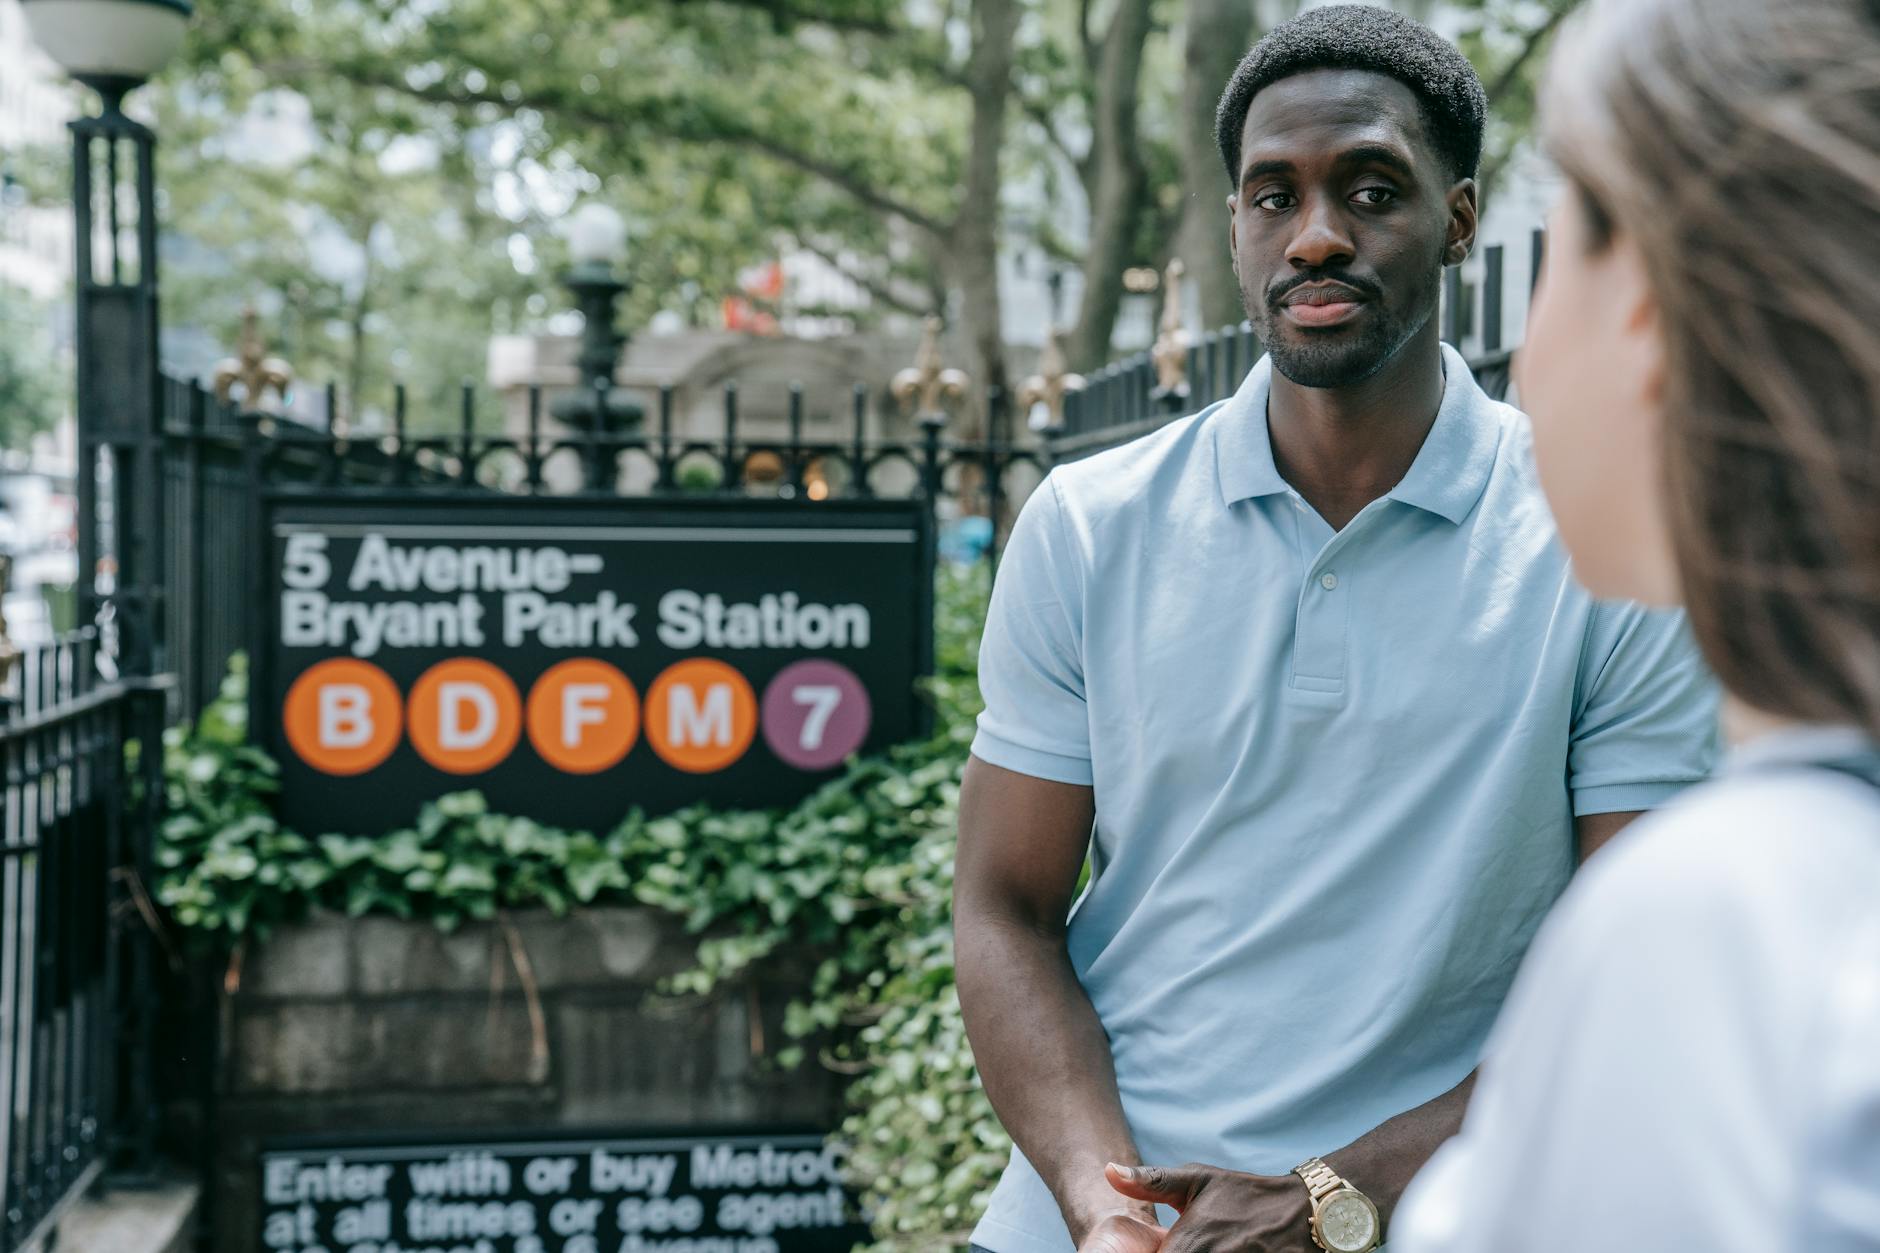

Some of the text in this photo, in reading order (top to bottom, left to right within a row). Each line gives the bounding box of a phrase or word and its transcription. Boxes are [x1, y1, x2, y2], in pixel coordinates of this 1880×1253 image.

[282, 533, 331, 589] 5
[280, 589, 871, 657] Bryant Park Station
[318, 682, 842, 750] B D F M 7
[265, 1157, 393, 1204] Enter
[408, 1150, 511, 1196] with
[523, 1157, 578, 1195] or
[590, 1148, 677, 1198] buy
[264, 1202, 317, 1248] at
[333, 1197, 391, 1245] all
[407, 1196, 537, 1241] times
[549, 1198, 604, 1236] or
[617, 1195, 704, 1233] see
[716, 1185, 844, 1236] agent
